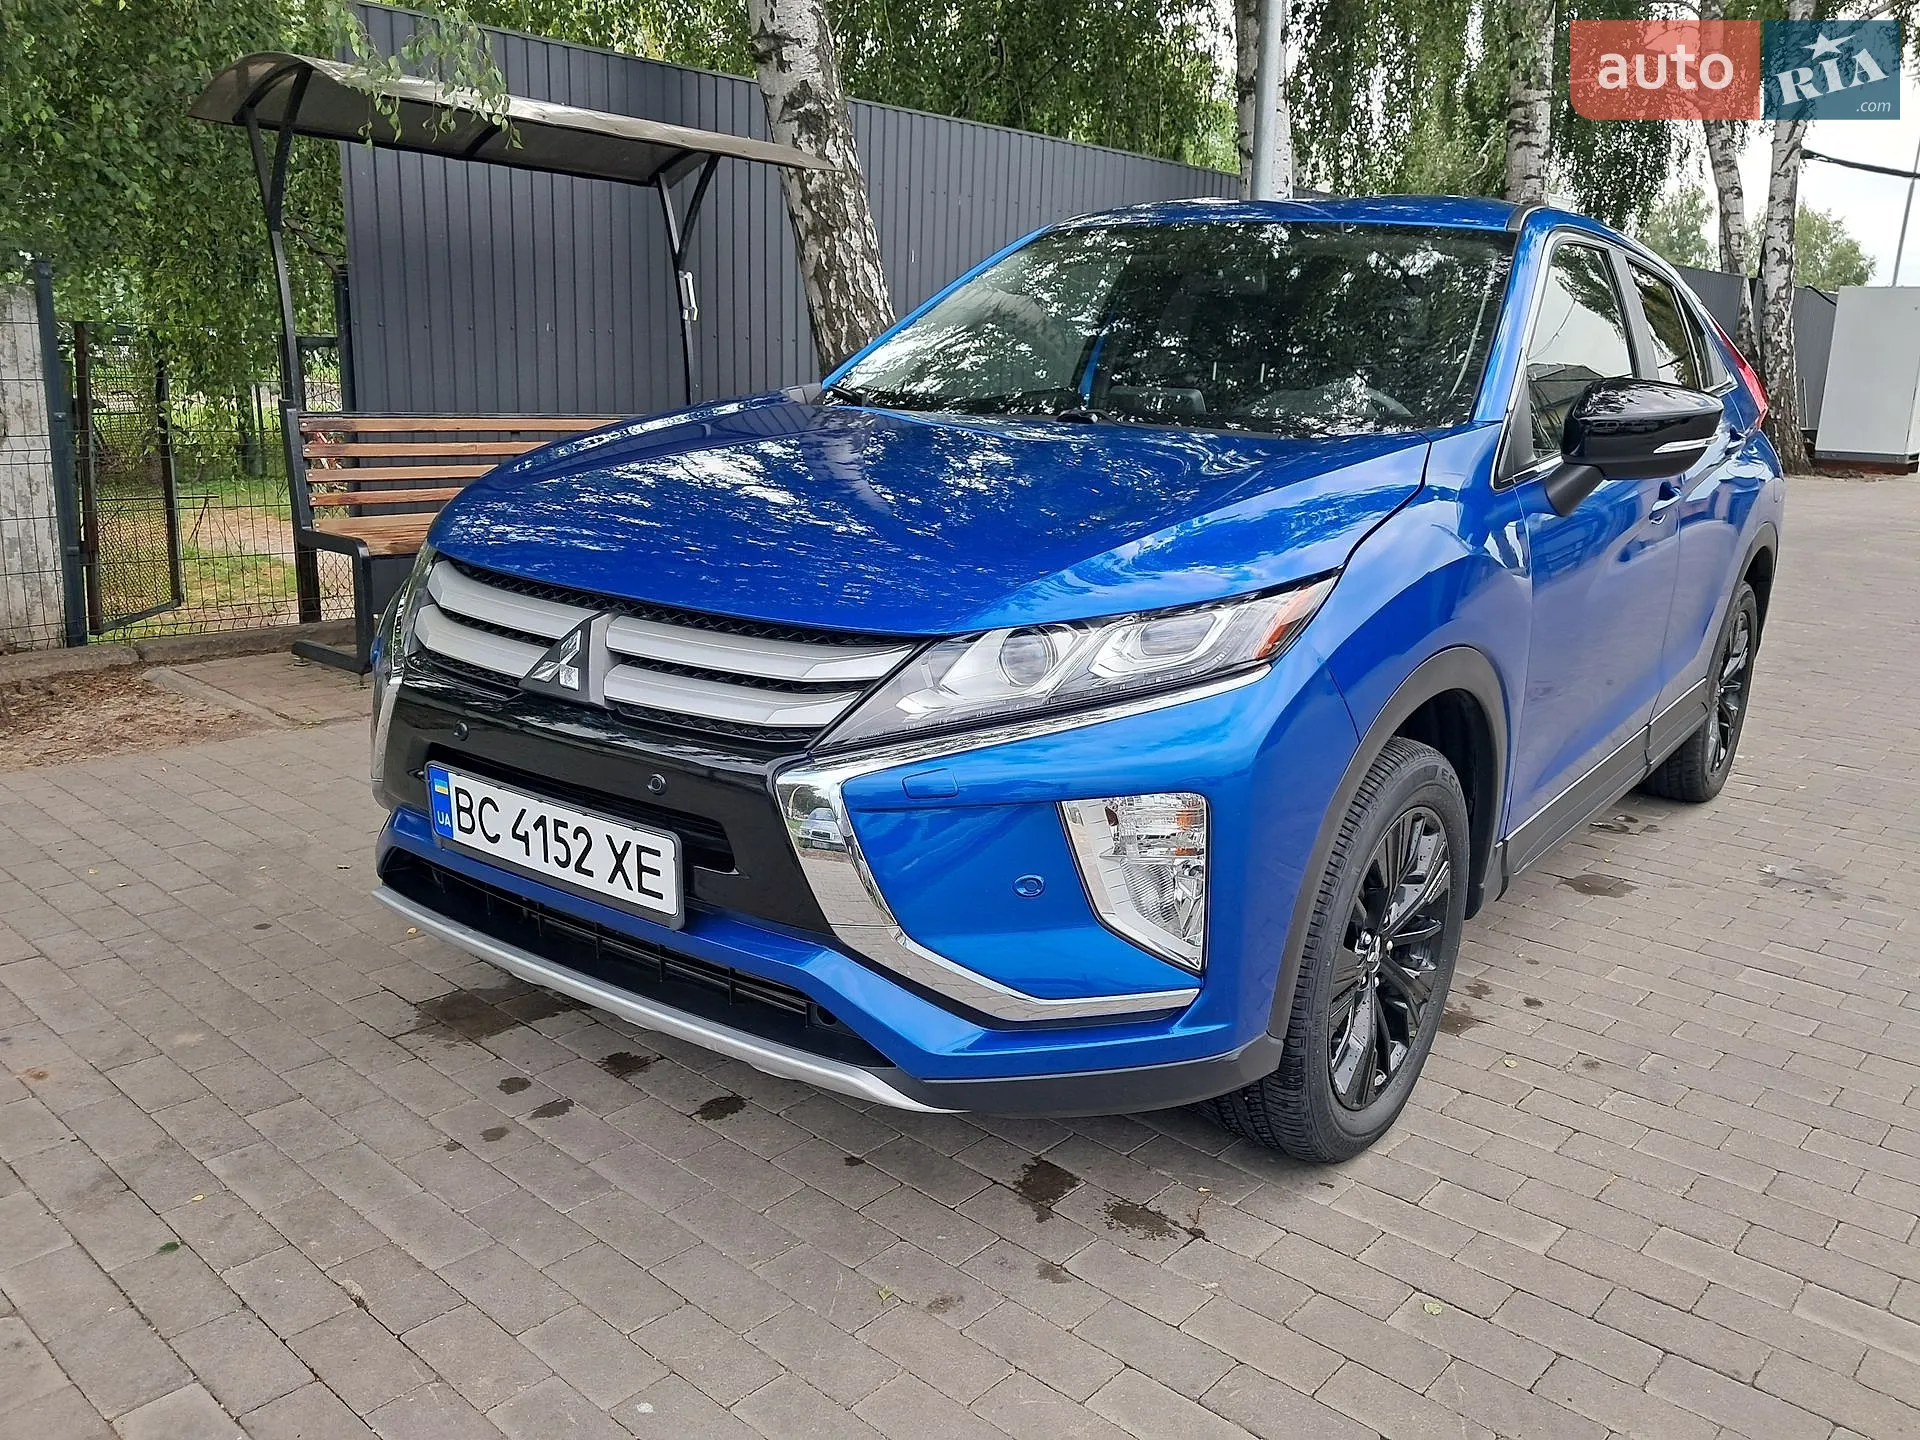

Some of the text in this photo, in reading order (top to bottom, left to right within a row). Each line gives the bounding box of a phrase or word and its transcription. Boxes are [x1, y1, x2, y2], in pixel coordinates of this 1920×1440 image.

[437, 810, 451, 828] UA
[454, 786, 664, 900] BC 4152 XE
